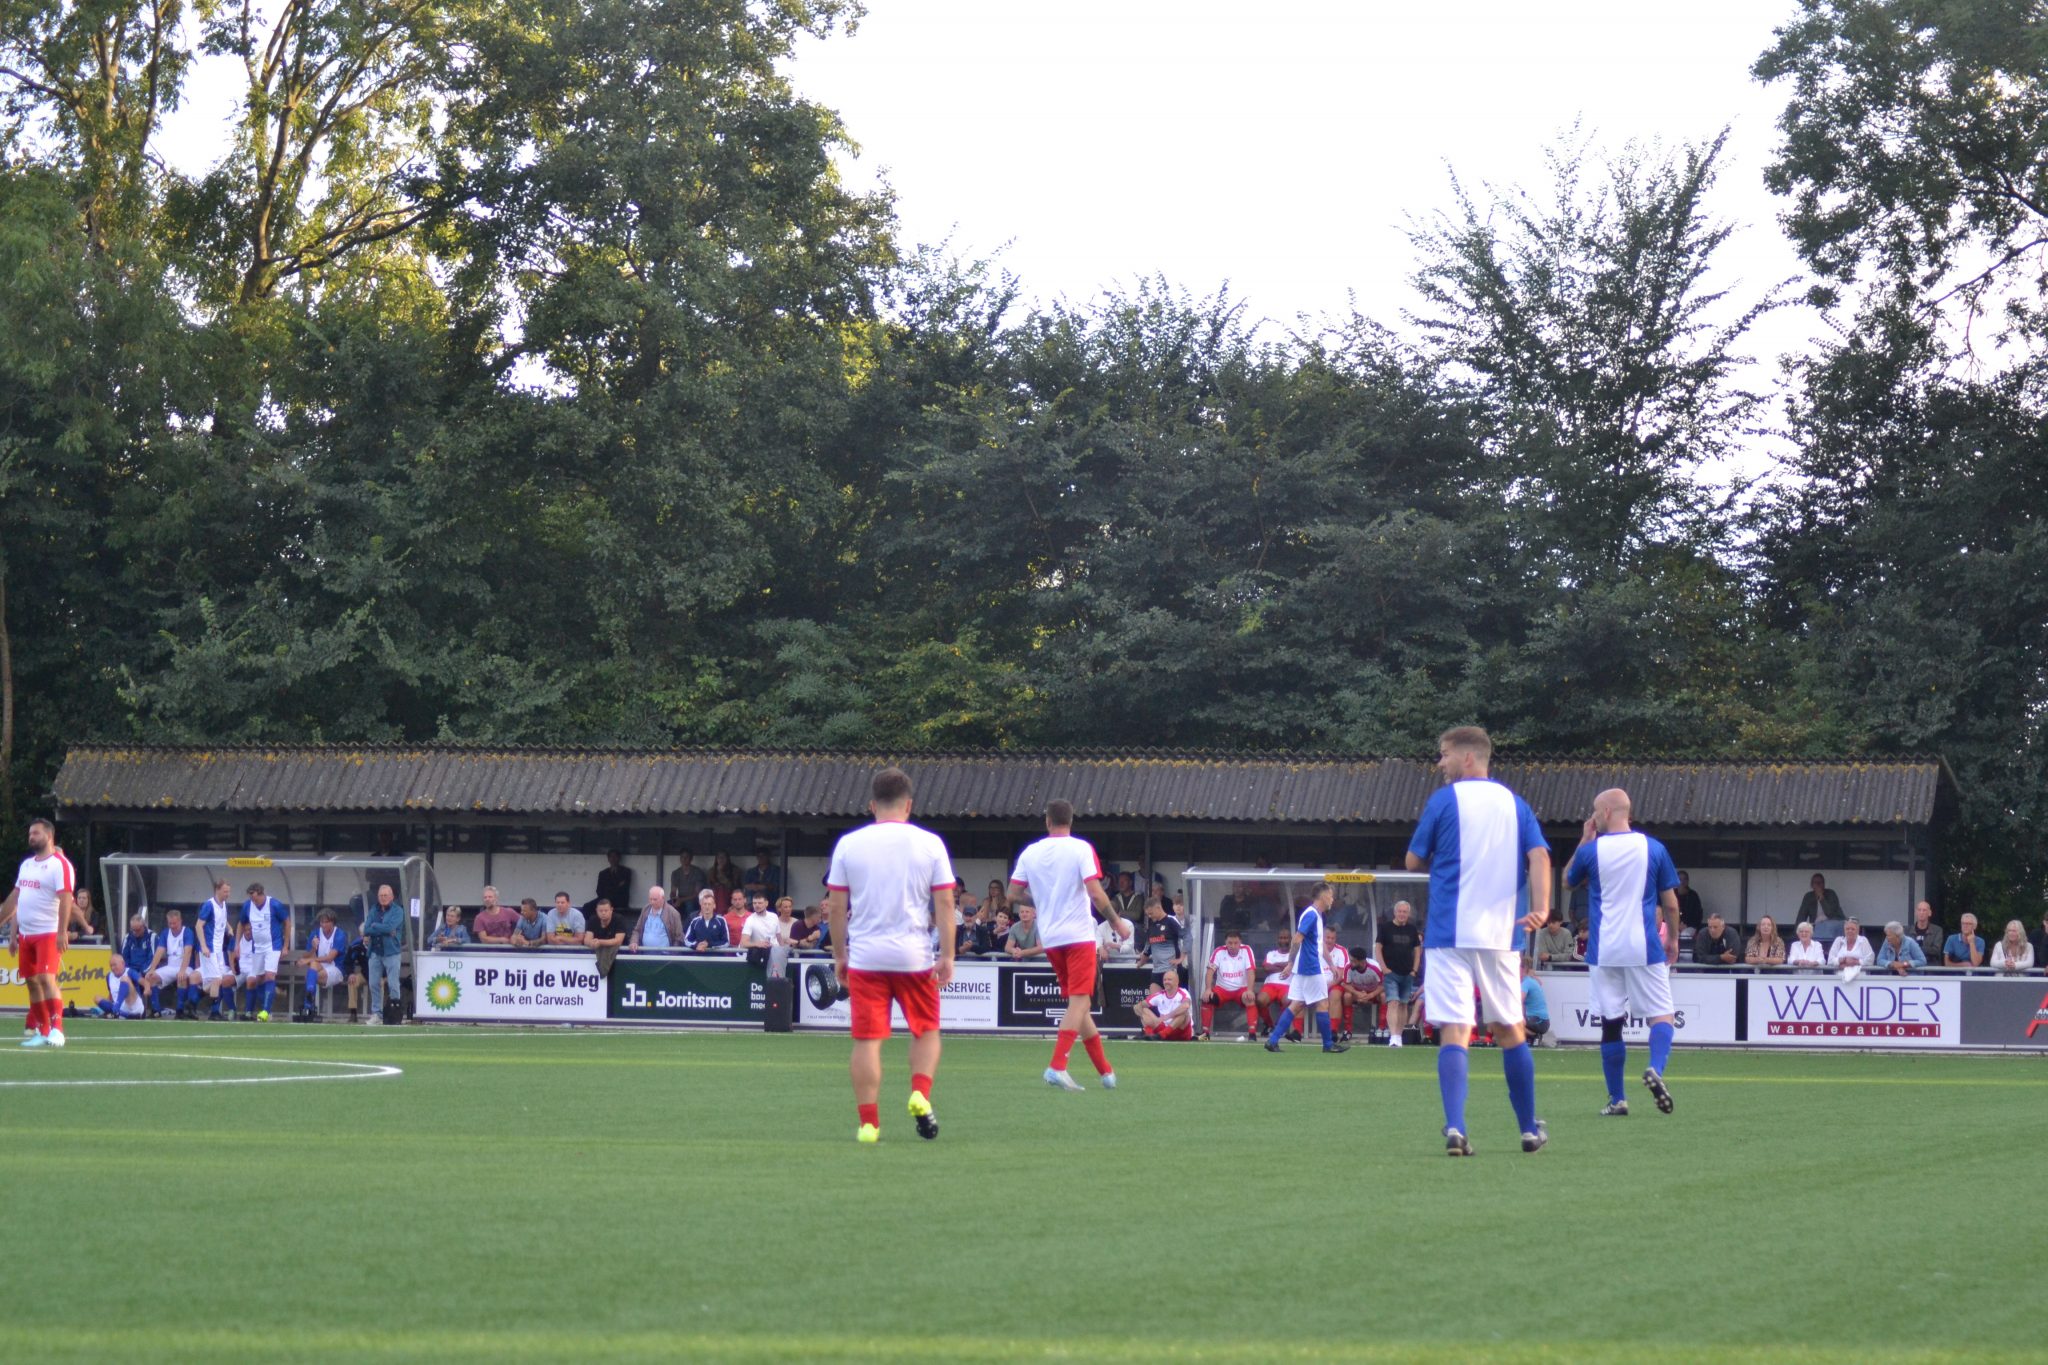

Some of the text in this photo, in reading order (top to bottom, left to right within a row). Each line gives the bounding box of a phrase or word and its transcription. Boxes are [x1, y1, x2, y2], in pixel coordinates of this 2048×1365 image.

[448, 958, 463, 972] bp
[57, 965, 105, 982] oistra
[474, 968, 599, 992] BP bij de Weg
[939, 982, 991, 993] NSERVICE
[1024, 980, 1061, 995] bruin
[1120, 988, 1143, 996] Melvin
[489, 993, 584, 1006] Tank en Carwash
[656, 991, 732, 1009] Jorritsma
[750, 992, 766, 1000] bou
[1768, 985, 1941, 1022] WANDER
[1770, 1024, 1940, 1036] wanderauto.nl
